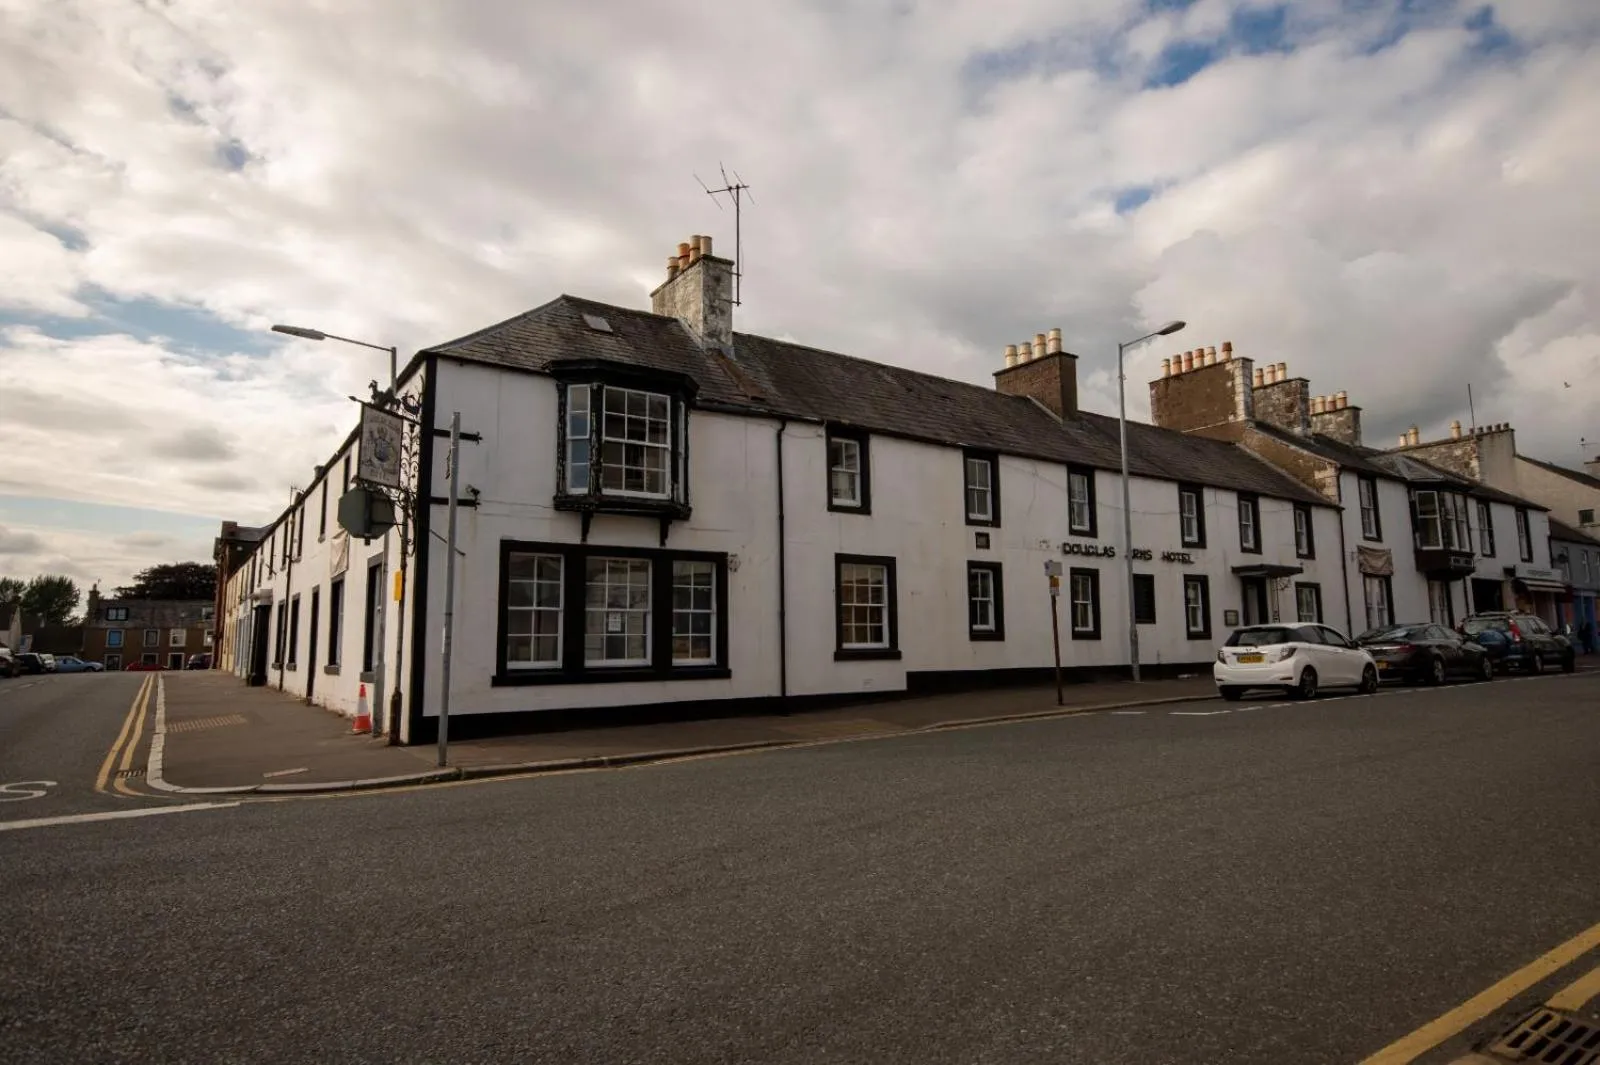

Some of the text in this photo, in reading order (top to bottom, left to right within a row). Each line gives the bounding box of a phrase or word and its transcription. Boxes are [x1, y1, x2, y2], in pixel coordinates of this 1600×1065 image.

[1062, 542, 1195, 565] DOUGLAS RMS HOTEL
